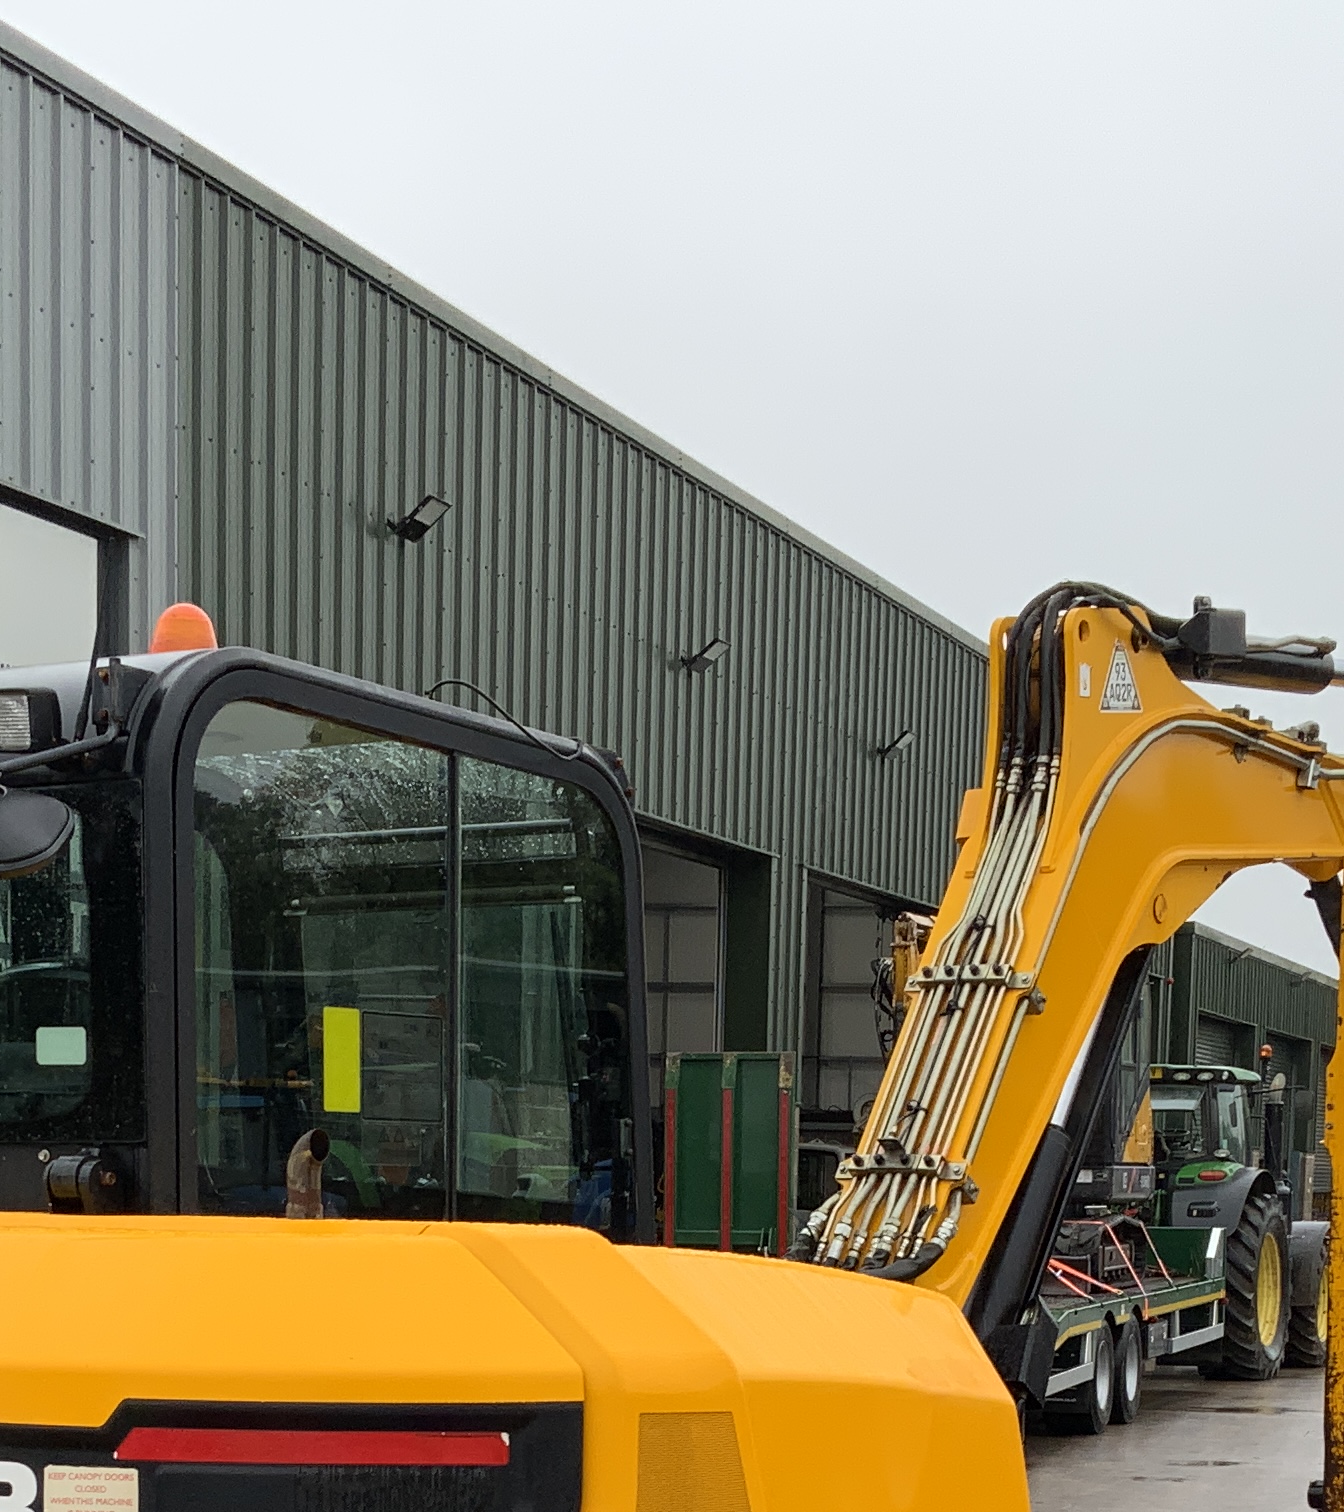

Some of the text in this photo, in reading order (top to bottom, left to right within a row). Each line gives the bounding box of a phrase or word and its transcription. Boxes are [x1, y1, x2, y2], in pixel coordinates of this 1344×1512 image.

[1115, 662, 1127, 681] 93
[48, 1472, 135, 1482] KEEP CANOPY DOORS
[74, 1485, 107, 1494] CLOSED
[50, 1497, 133, 1507] WHEN THIS MACHINE
